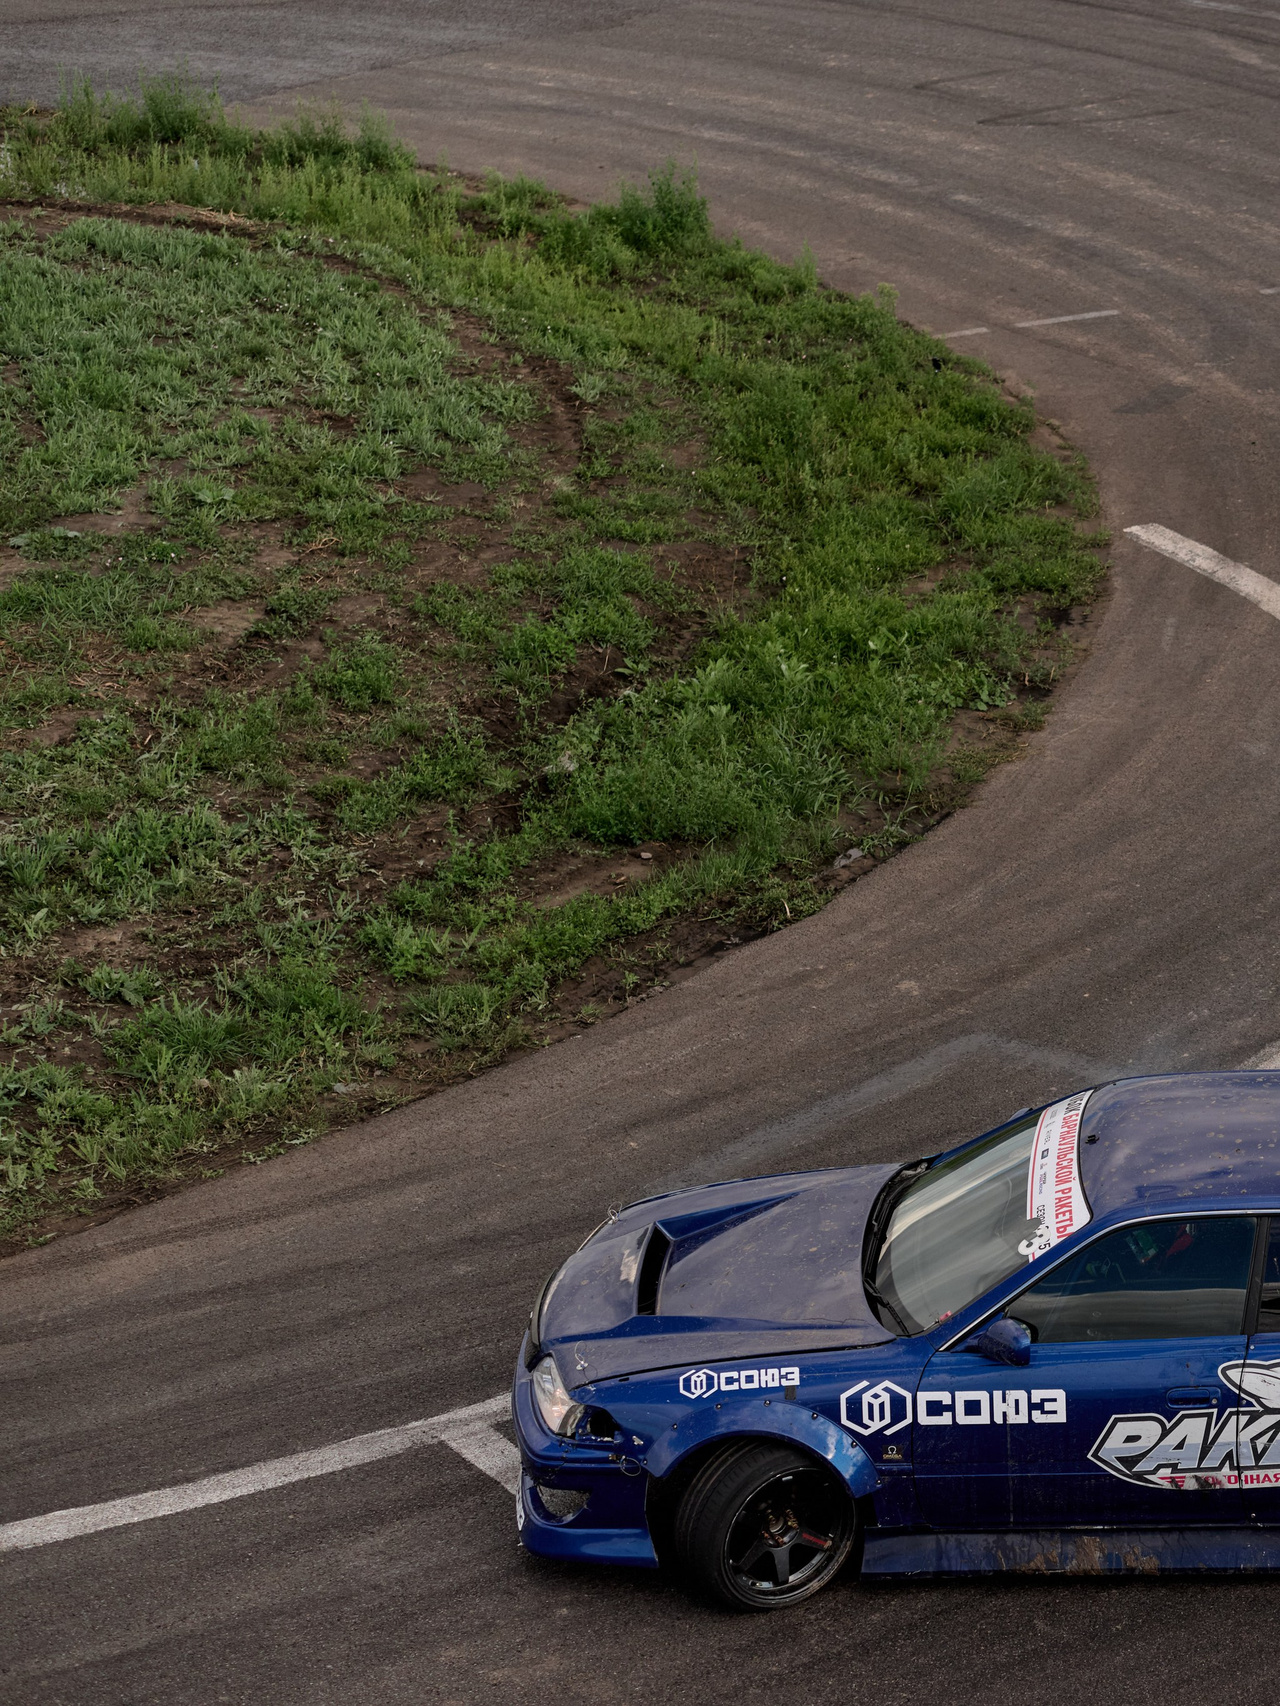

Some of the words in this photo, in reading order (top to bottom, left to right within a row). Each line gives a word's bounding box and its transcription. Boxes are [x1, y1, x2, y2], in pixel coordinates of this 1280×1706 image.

[1055, 1113, 1079, 1187] БАРНАУЛЬСКОЙ
[1055, 1186, 1074, 1239] РАКЕТЫ
[719, 1367, 800, 1391] СОЮЗ
[916, 1388, 1067, 1425] СОЮЗ
